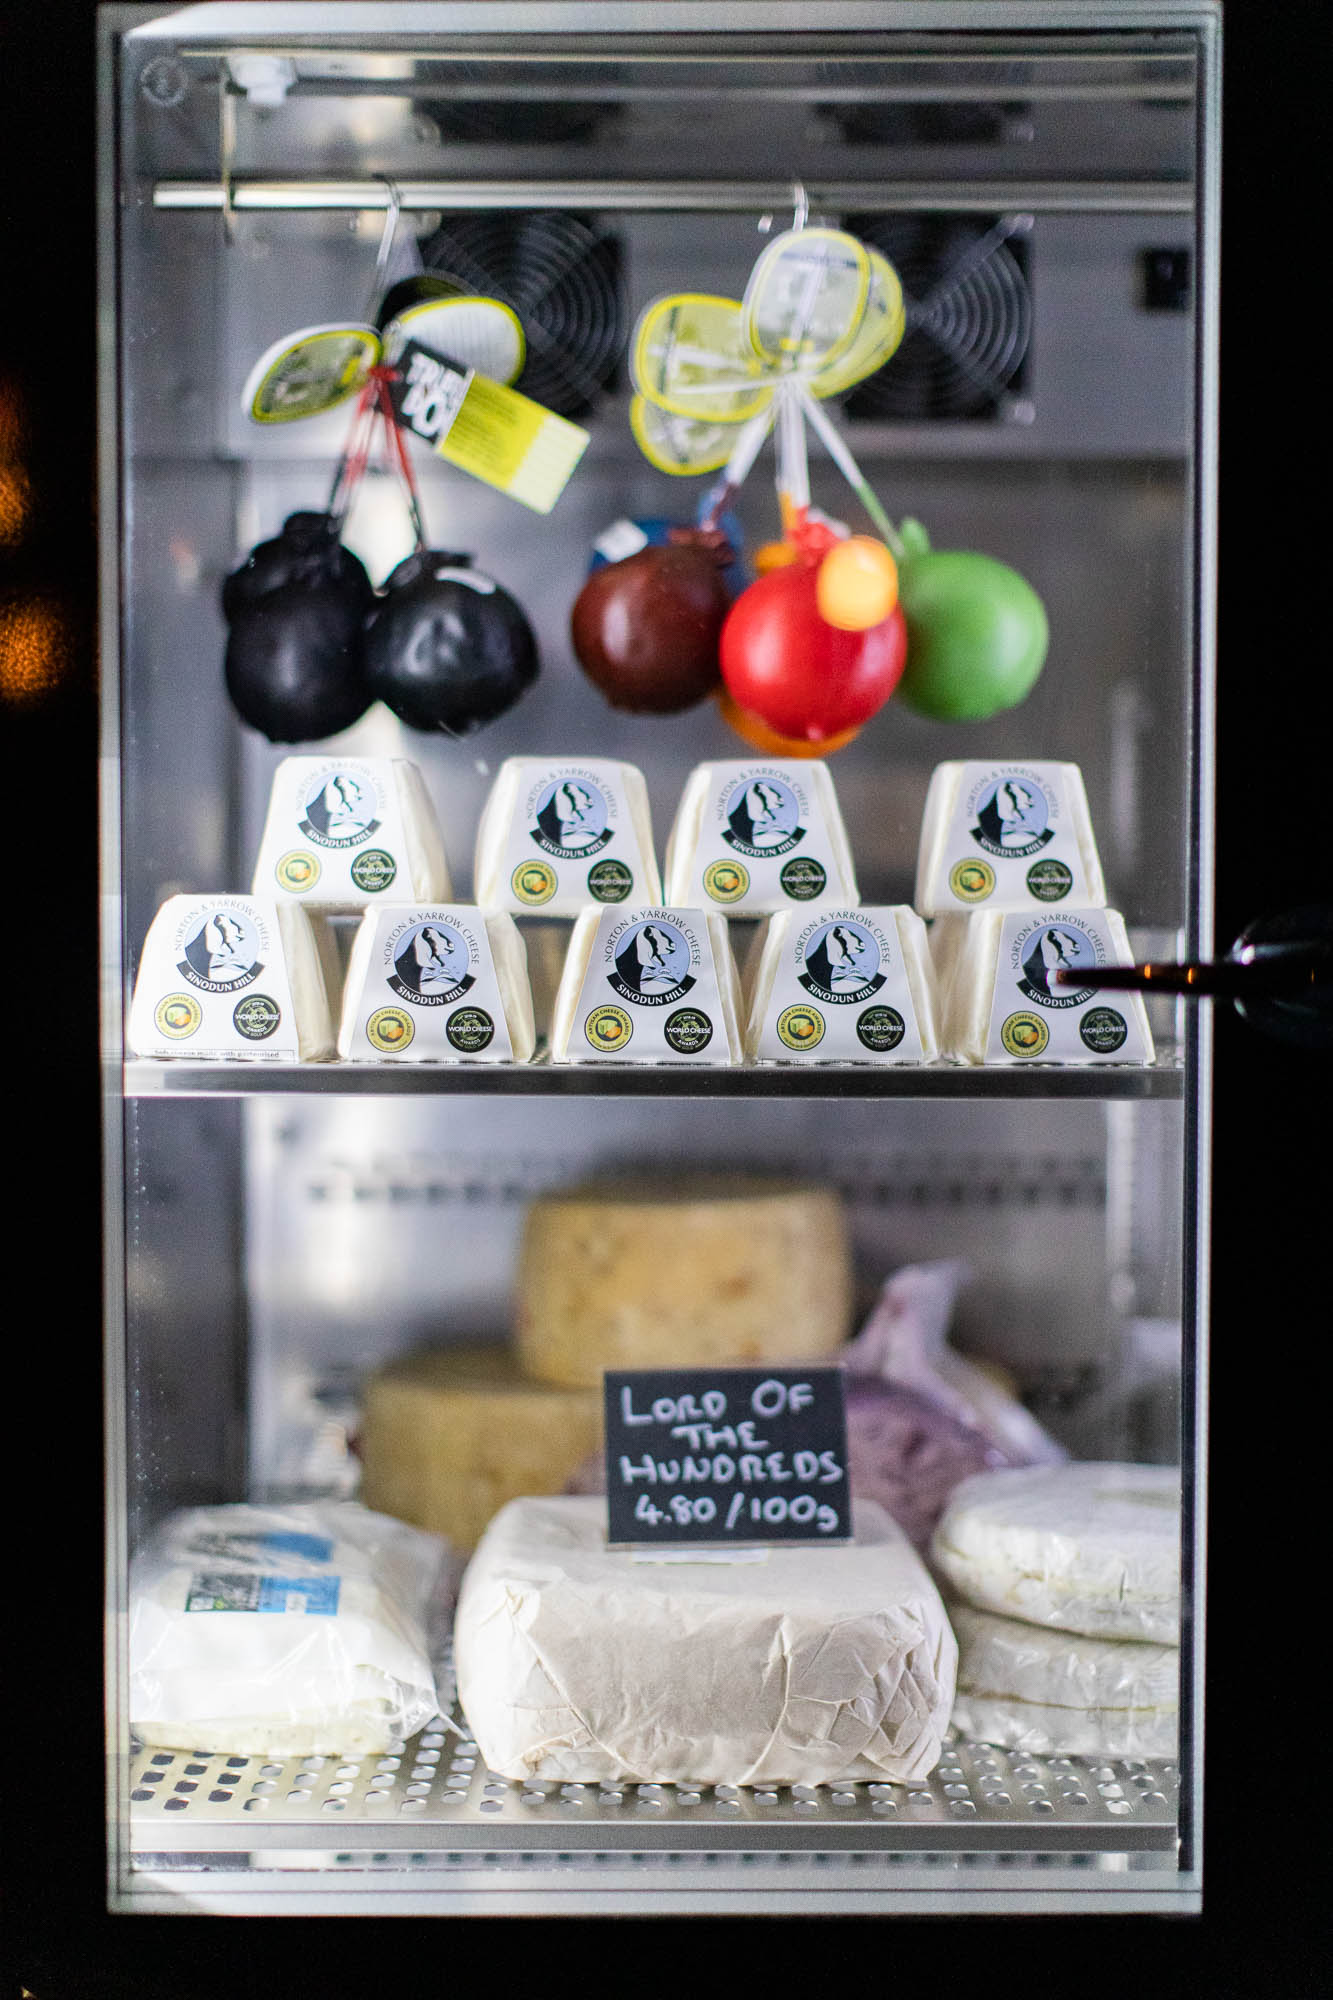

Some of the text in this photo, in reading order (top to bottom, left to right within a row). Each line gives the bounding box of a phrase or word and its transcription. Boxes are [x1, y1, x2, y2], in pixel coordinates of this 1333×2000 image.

[308, 828, 374, 848] SINODUN HILL
[731, 838, 798, 857] SINODUN HILL
[980, 837, 1045, 858] SINODUN HILL
[540, 839, 606, 858] SINODUN HILL
[384, 912, 480, 966] NORTON & YARROW CHEESE
[604, 910, 700, 966] NORTON & YARROW CHEESE
[794, 922, 818, 965] NORTON
[828, 911, 874, 928] YARROW
[873, 928, 890, 964] CHEESE
[1010, 926, 1032, 969] NORTON
[1033, 919, 1041, 928] &
[1041, 913, 1088, 930] YARROW
[186, 972, 256, 992] SINODUN HILL
[398, 985, 466, 1005] SINODUN HILL
[616, 983, 686, 1005] SINODUN HILL
[807, 983, 877, 1003] SINODUN HILL
[1027, 989, 1074, 1008] SINODUN
[689, 1026, 711, 1034] CHEESE
[1104, 1025, 1126, 1033] CHEESE
[620, 1379, 815, 1427] LORD OF
[671, 1420, 770, 1451] THE
[619, 1450, 842, 1485] HUNDREDS
